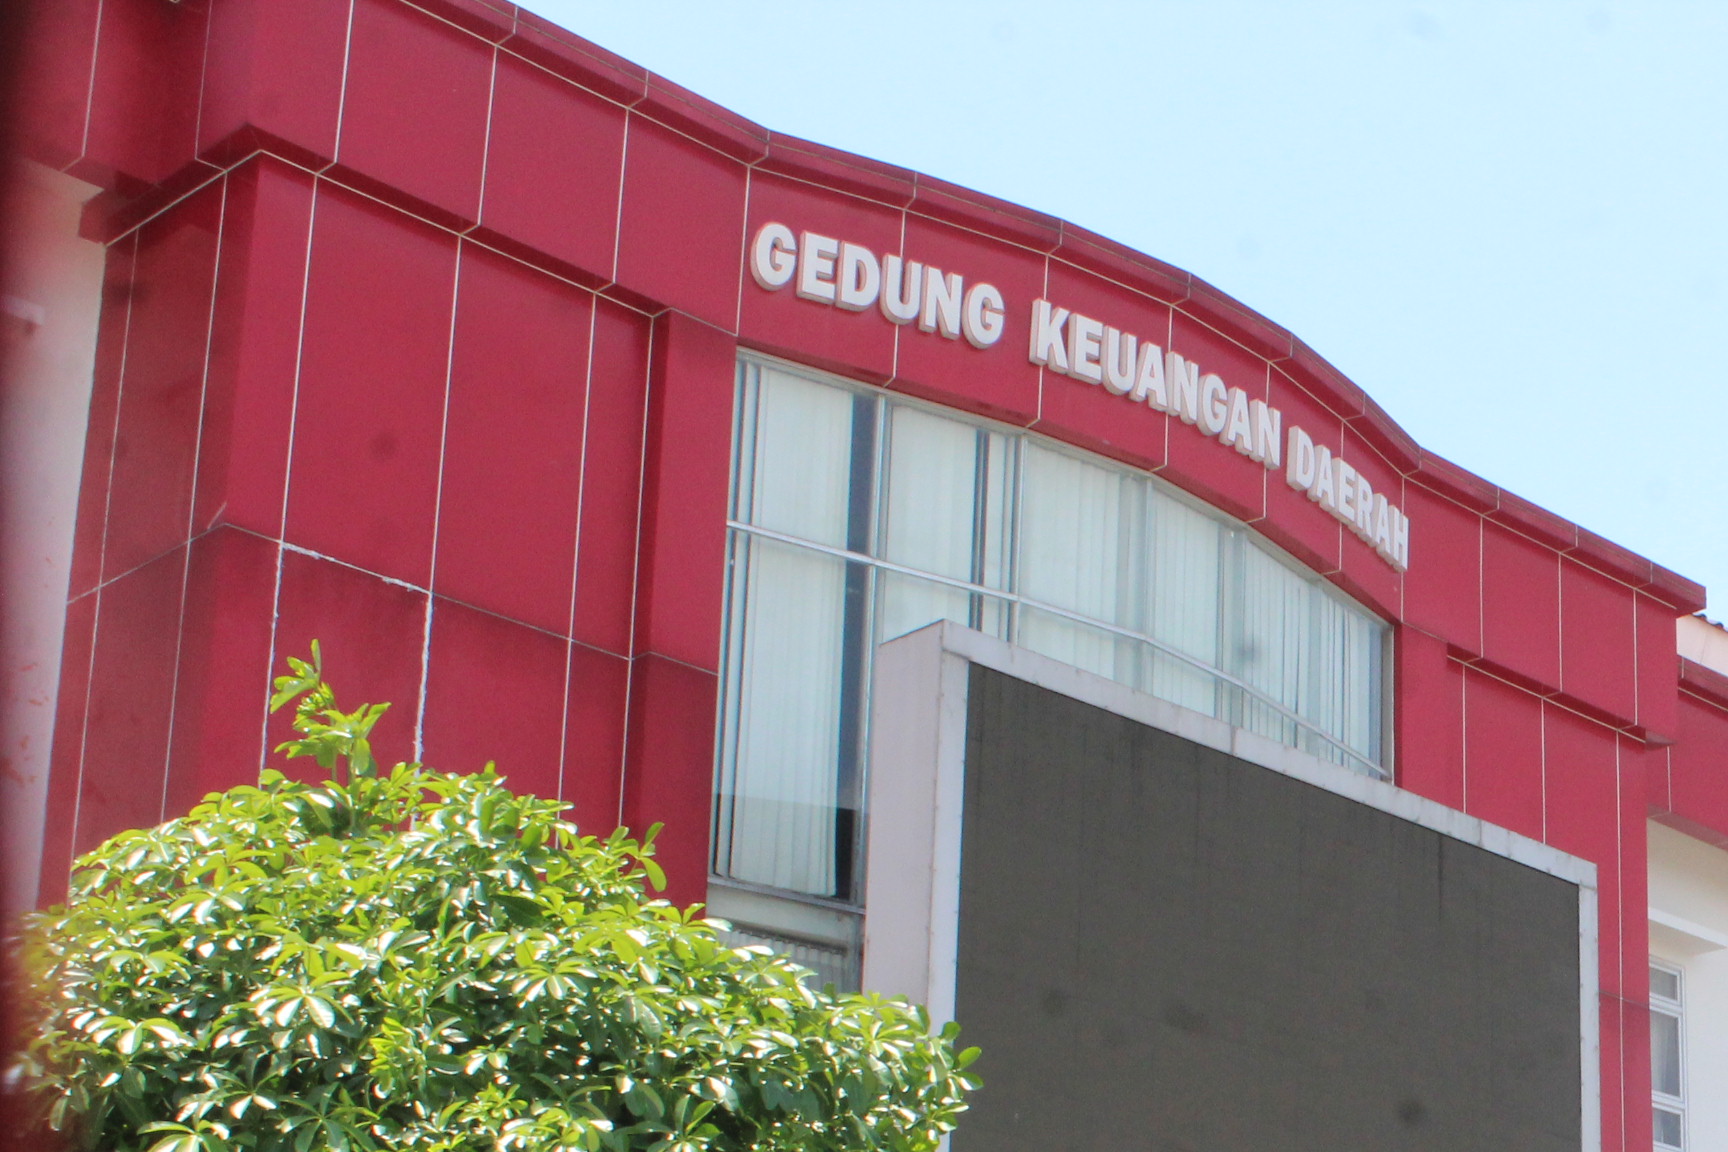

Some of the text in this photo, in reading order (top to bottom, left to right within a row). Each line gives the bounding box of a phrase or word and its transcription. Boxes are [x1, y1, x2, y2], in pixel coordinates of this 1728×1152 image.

[750, 223, 1410, 572] GEDUNG KEUANGAN DAERAH
